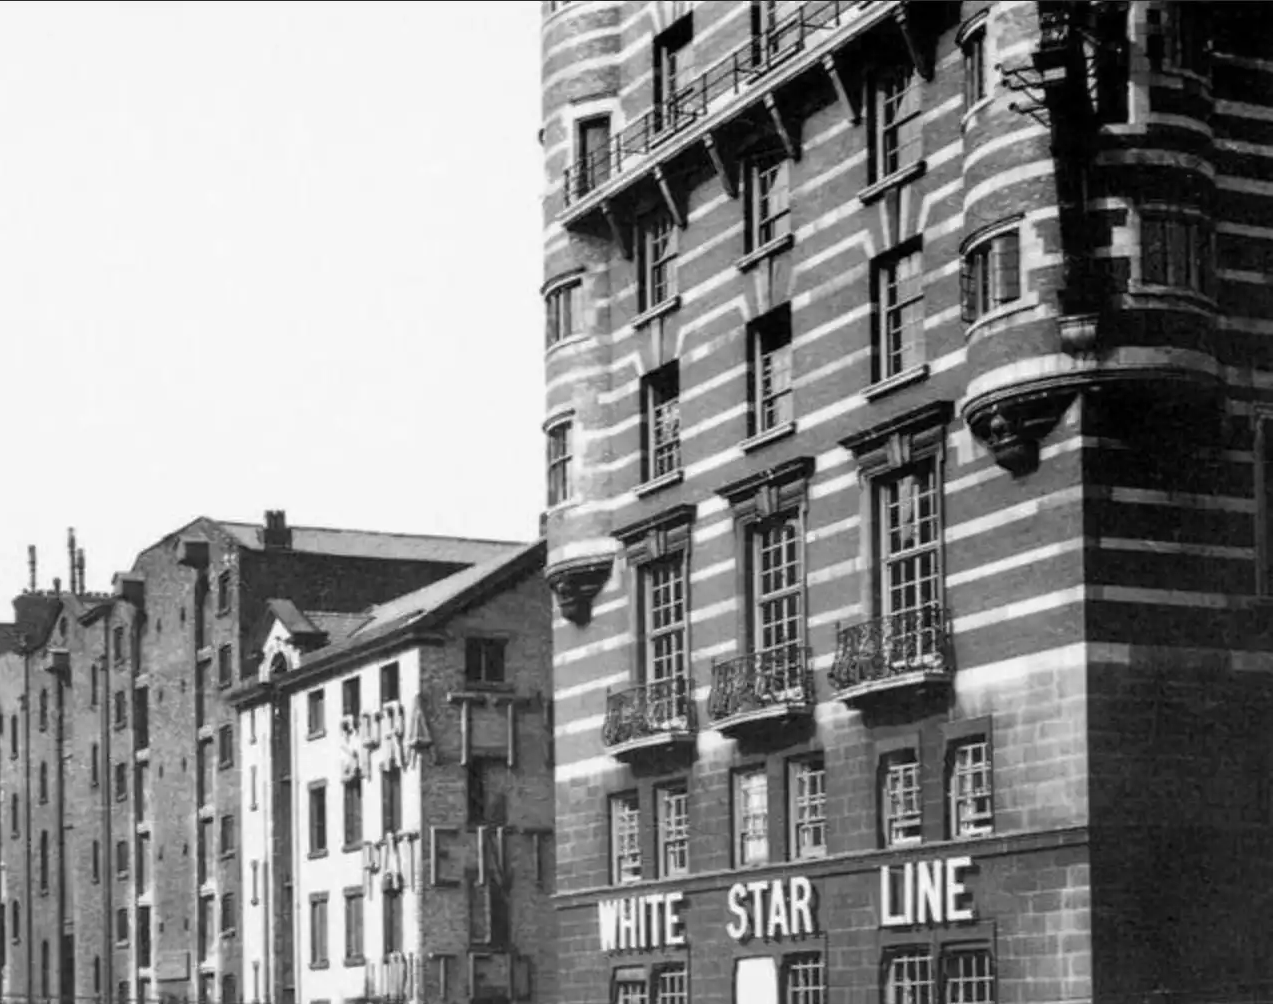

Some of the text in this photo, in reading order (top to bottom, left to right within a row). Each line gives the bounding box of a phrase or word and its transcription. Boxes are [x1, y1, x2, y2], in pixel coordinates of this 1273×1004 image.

[598, 857, 974, 951] WHITE STAR LINE
